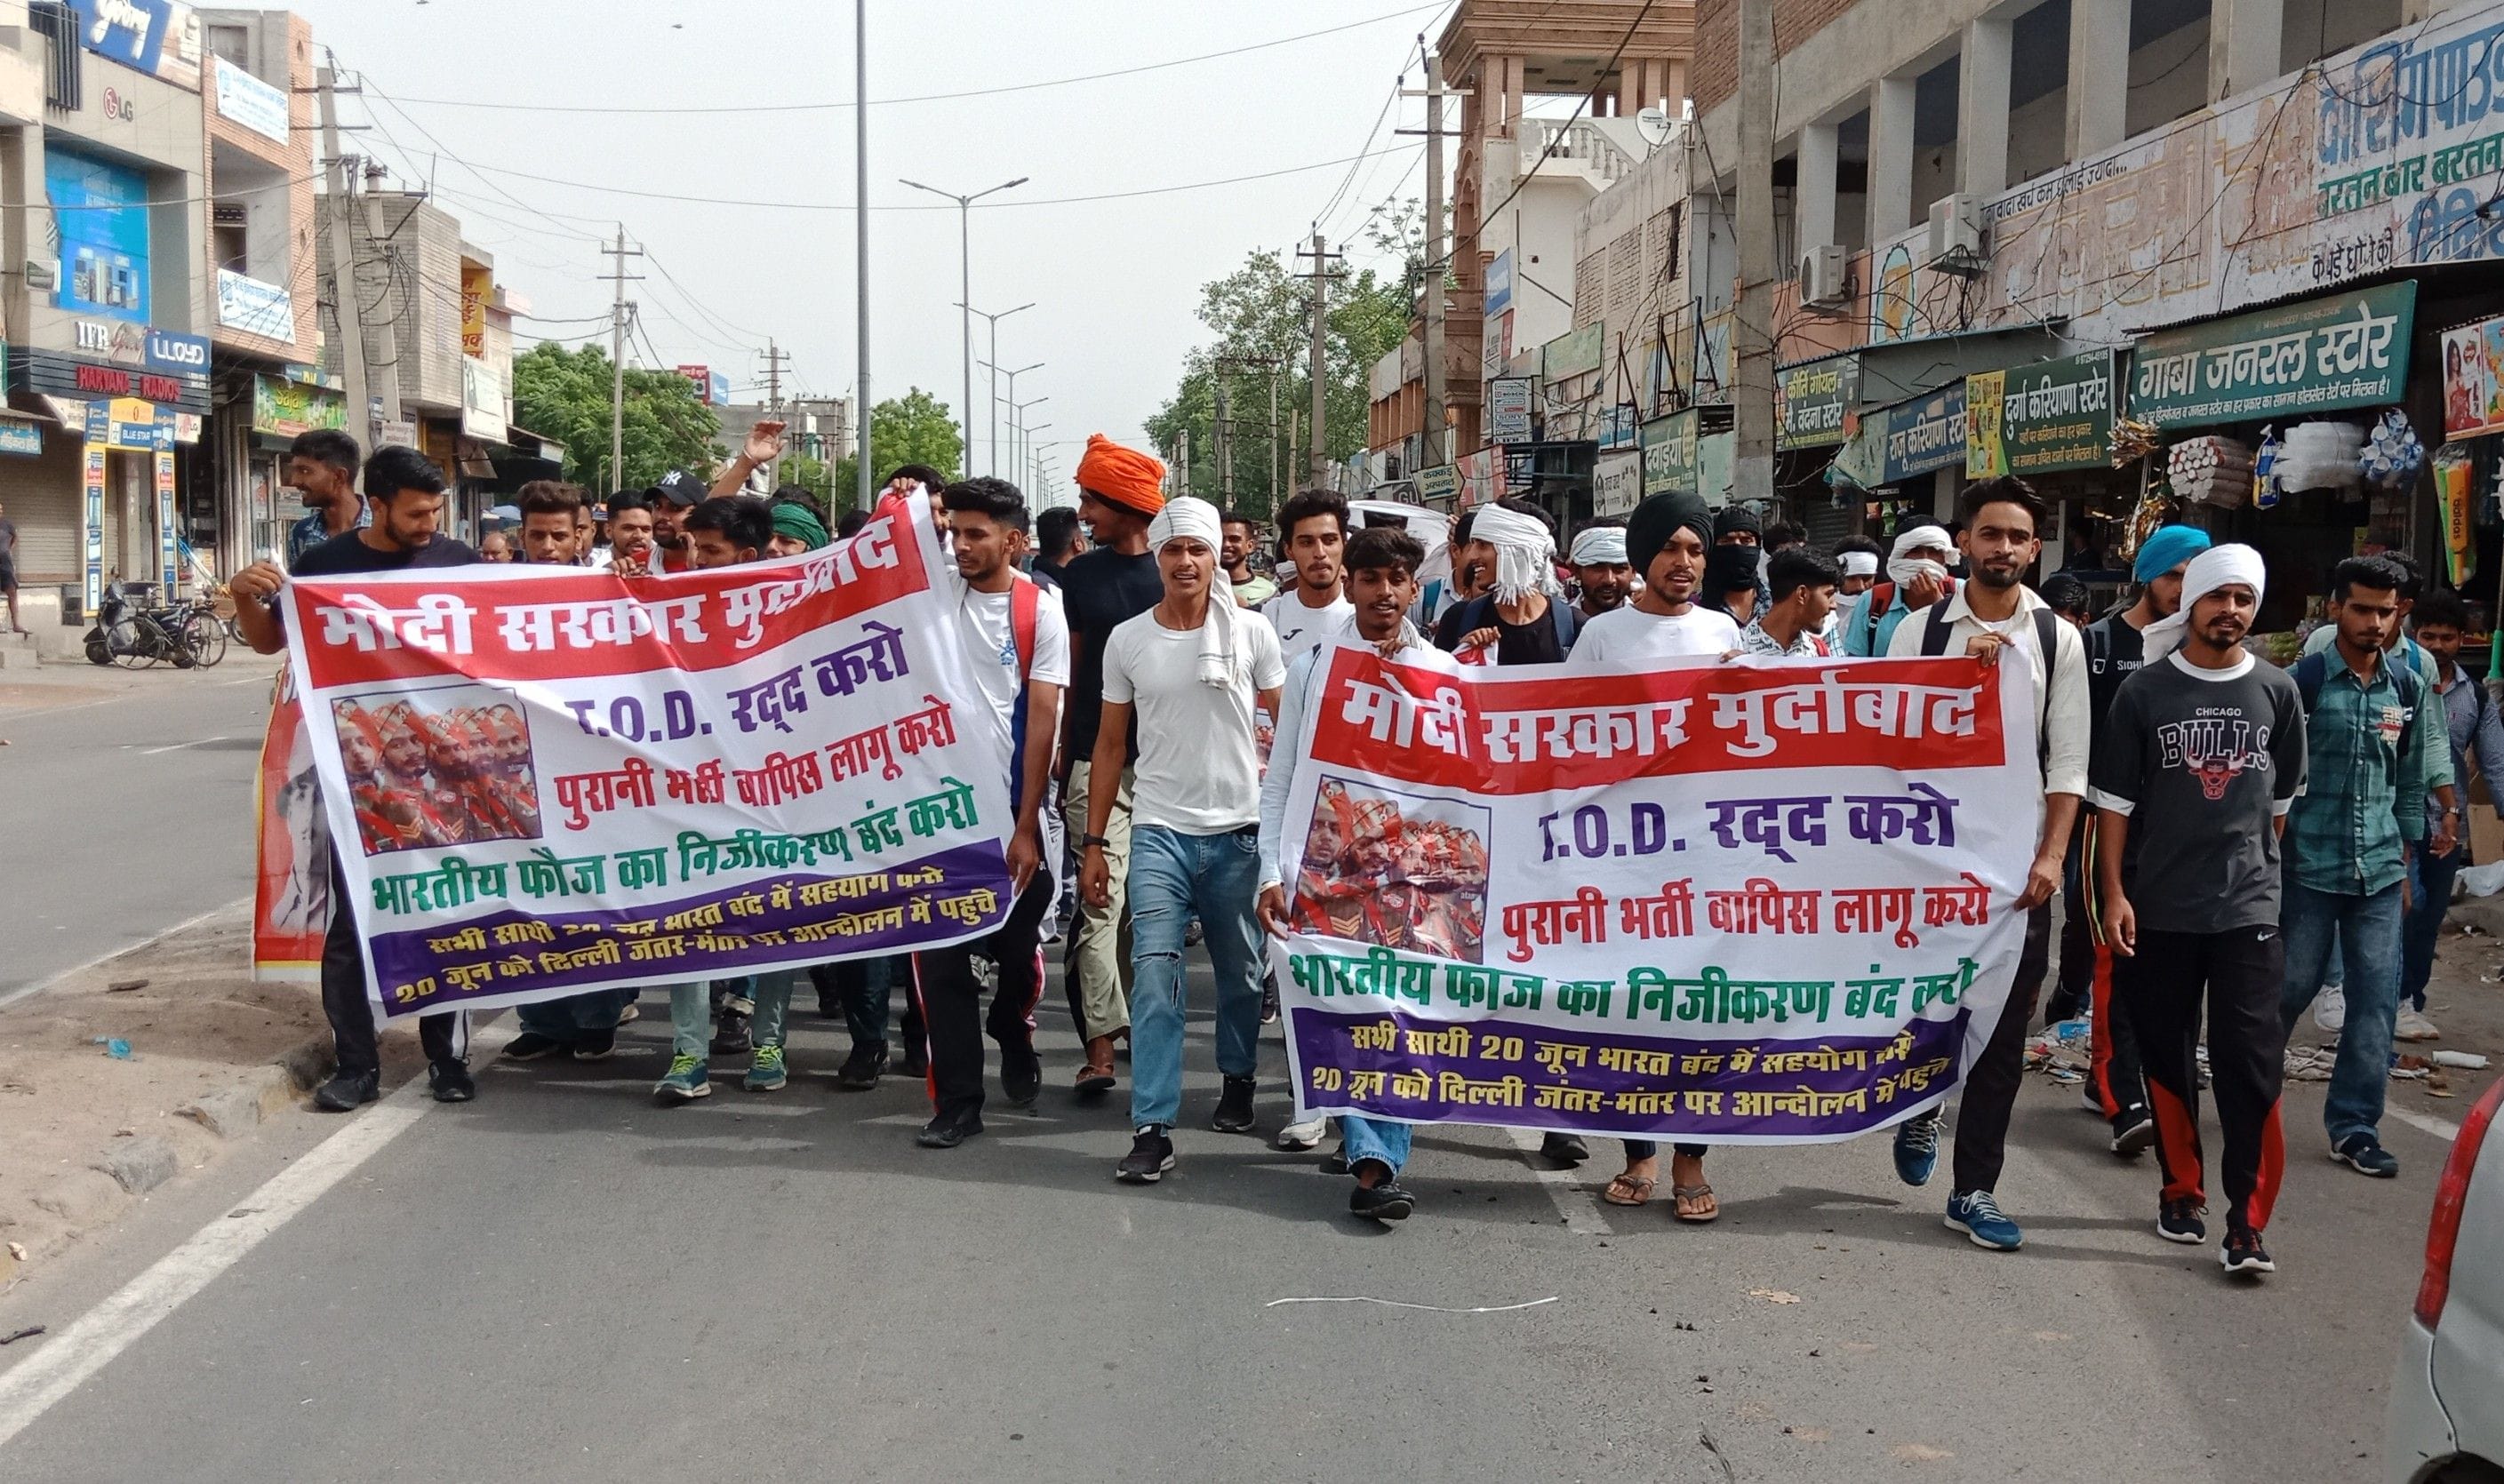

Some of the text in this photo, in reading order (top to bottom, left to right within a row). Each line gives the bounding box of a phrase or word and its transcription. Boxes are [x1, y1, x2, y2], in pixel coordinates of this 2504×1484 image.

[117, 95, 133, 123] LG
[152, 338, 205, 365] LLOYD
[2139, 351, 2201, 400] गाबा
[2205, 331, 2313, 390] जनरल
[2316, 299, 2398, 377] स्टोर
[1798, 399, 1822, 432] वंदना
[1822, 394, 1843, 427] स्टोर
[1948, 400, 1967, 445] स्टो
[2005, 366, 2108, 441] दुर्गा करियाणा स्टोर
[2452, 498, 2463, 541] adidas
[316, 593, 476, 656] मोदी
[494, 594, 708, 652] सरकार
[811, 620, 909, 698] करो
[1342, 669, 1982, 765] मोदी सरकार मुर्दाबाद
[2157, 719, 2271, 772] BULLS
[2195, 706, 2243, 717] CHICAGO
[554, 756, 656, 831] पुरानी
[732, 751, 823, 807] वापिस
[824, 724, 903, 782] लागू
[893, 694, 956, 755] करो
[370, 776, 980, 916] भारतीय फौज का निजीकरण बंद करो
[1538, 802, 1687, 863] T.O.D.
[1844, 783, 1959, 850] करो
[396, 977, 437, 1003] 20
[442, 961, 493, 991] जून
[496, 955, 537, 978] को
[539, 938, 621, 975] दिल्ली
[789, 906, 904, 945] आन्दोलन
[908, 893, 933, 923] में
[426, 926, 487, 954] सभी
[663, 902, 724, 931] भारत
[726, 890, 764, 917] बंद
[770, 881, 795, 911] में
[1501, 871, 1991, 962] पुरानी भर्ती वापिस लागू करो
[1289, 945, 1436, 1007] भारतीय
[1556, 978, 1616, 1019] का
[1626, 965, 1836, 1025] निजीकरण
[1844, 963, 1906, 1019] बंद
[1348, 1018, 1400, 1052] सभी
[1404, 1025, 1474, 1059] साथी
[1480, 1034, 1524, 1062] 20
[1533, 1040, 1591, 1075] जून
[1597, 1045, 1675, 1077] भारत
[1680, 1048, 1726, 1077] बंद
[1729, 1045, 1761, 1074] में
[1760, 1044, 1868, 1075] सहयोग
[1311, 1066, 1342, 1091] 20
[1348, 1069, 1388, 1102] जून
[1391, 1067, 1434, 1103] को
[1438, 1072, 1526, 1108] दिल्ली
[1533, 1078, 1677, 1116] जंतर-मंतर
[1684, 1089, 1725, 1116] पर
[1732, 1083, 1868, 1118] आन्दोलन
[1874, 1073, 1900, 1105] में
